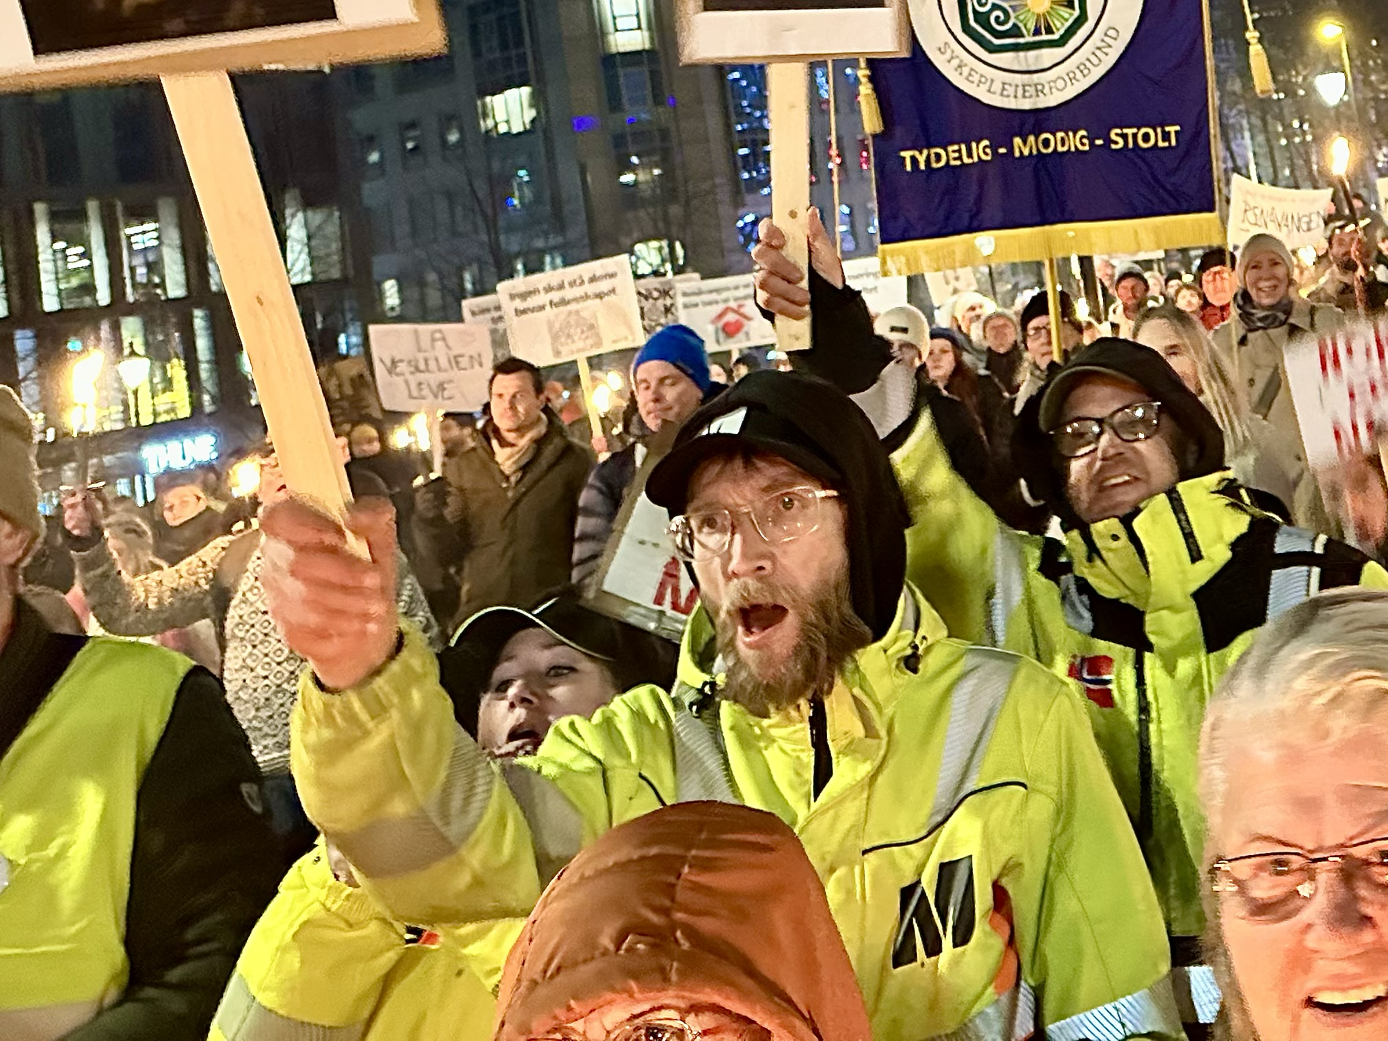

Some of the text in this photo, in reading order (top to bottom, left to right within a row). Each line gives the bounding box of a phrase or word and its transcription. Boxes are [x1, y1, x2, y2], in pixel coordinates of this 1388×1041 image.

[937, 25, 1121, 100] SYKEPLEIERFORBUND
[899, 140, 992, 172] TYDELIG
[1013, 129, 1089, 158] MODIG
[1109, 125, 1181, 150] STOLT
[414, 328, 449, 350] LA
[406, 379, 454, 401] LEVE
